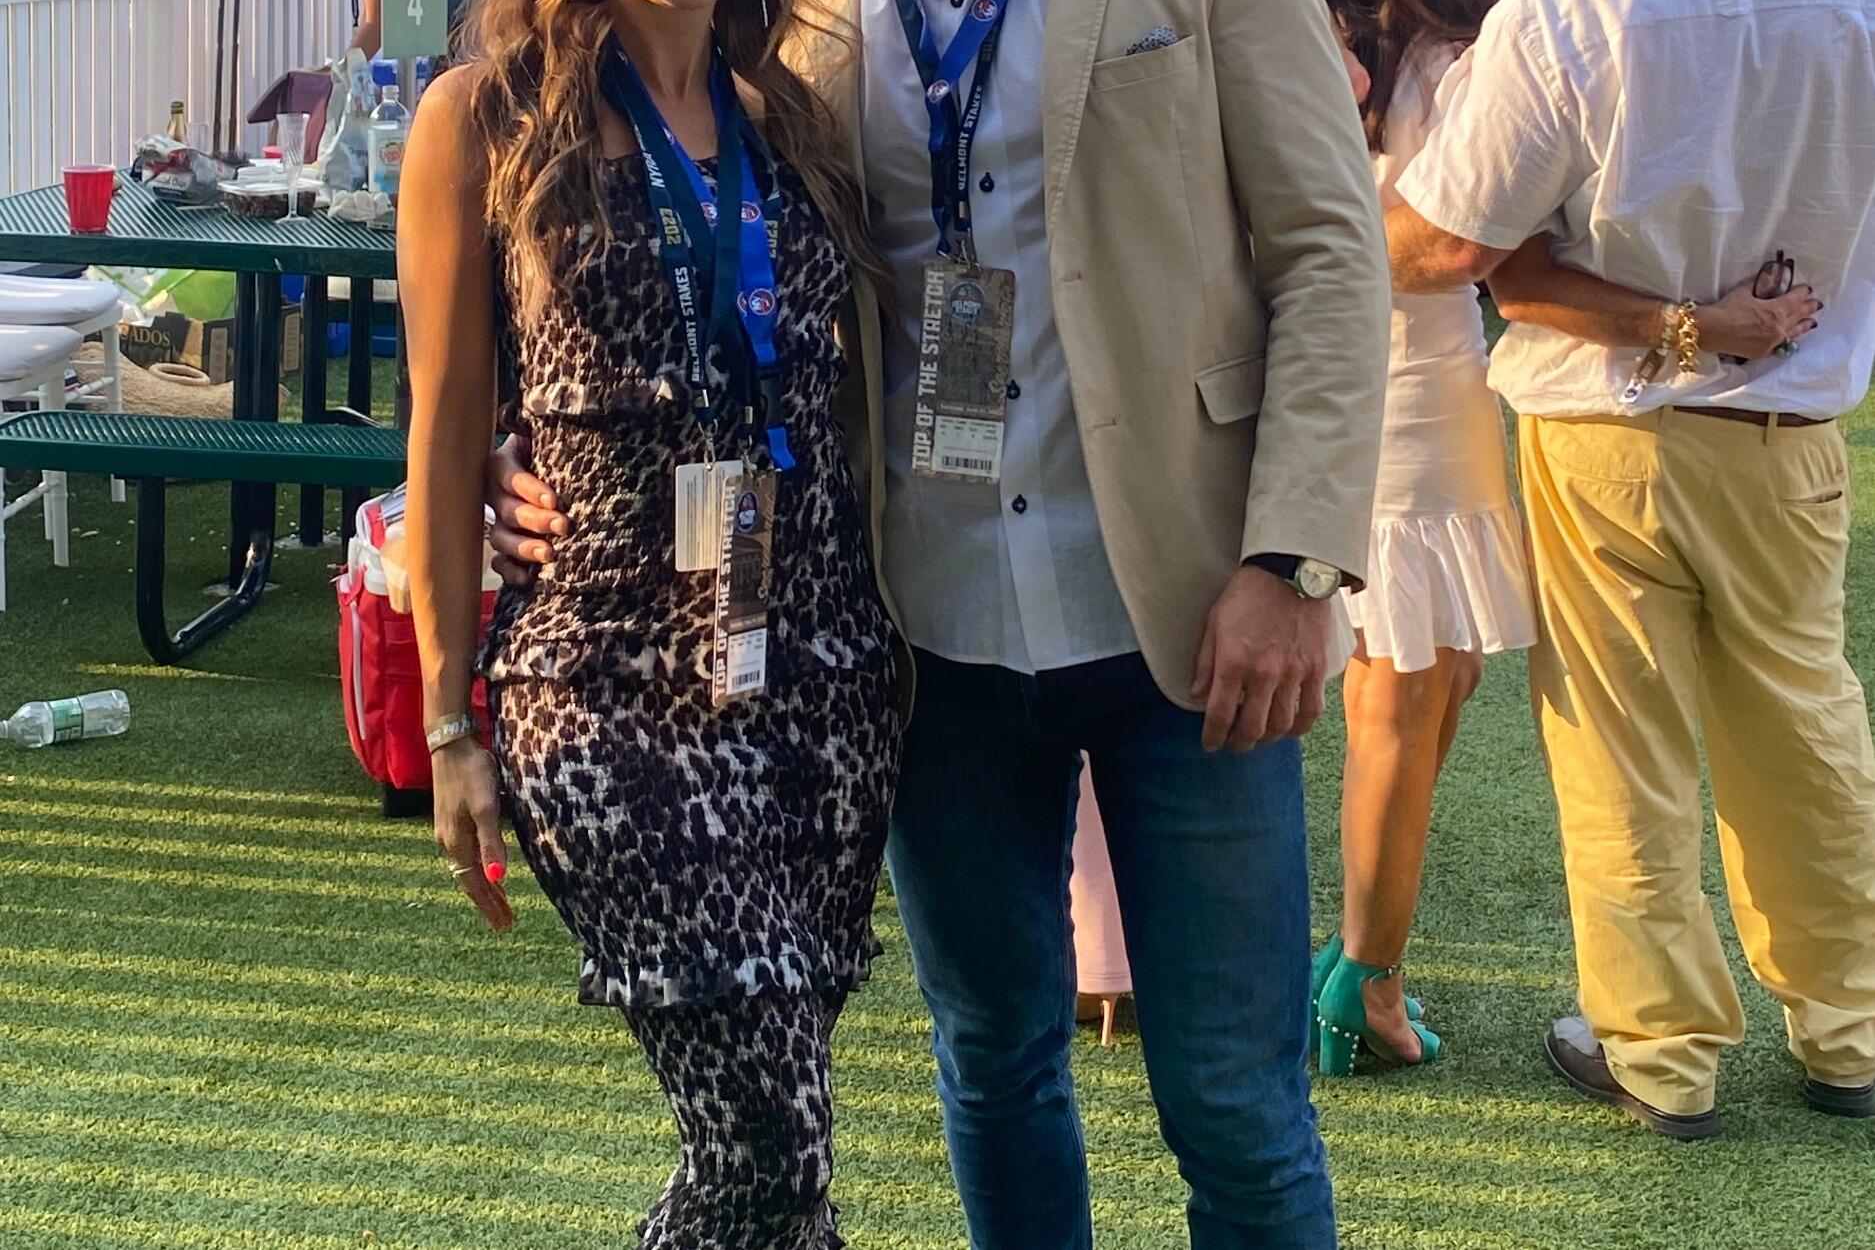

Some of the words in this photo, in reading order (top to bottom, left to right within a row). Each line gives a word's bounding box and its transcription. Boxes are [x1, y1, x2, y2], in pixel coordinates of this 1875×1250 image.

[957, 131, 969, 190] BELMONT
[659, 207, 682, 245] 2023
[675, 266, 695, 317] STAKES
[921, 269, 945, 356] STRETCH
[686, 320, 700, 382] BELMONT
[918, 361, 939, 397] THE
[915, 401, 934, 427] OF
[911, 431, 932, 469] TOP
[720, 485, 737, 577] STRETCH
[718, 580, 731, 620] THE
[714, 657, 727, 694] TOP
